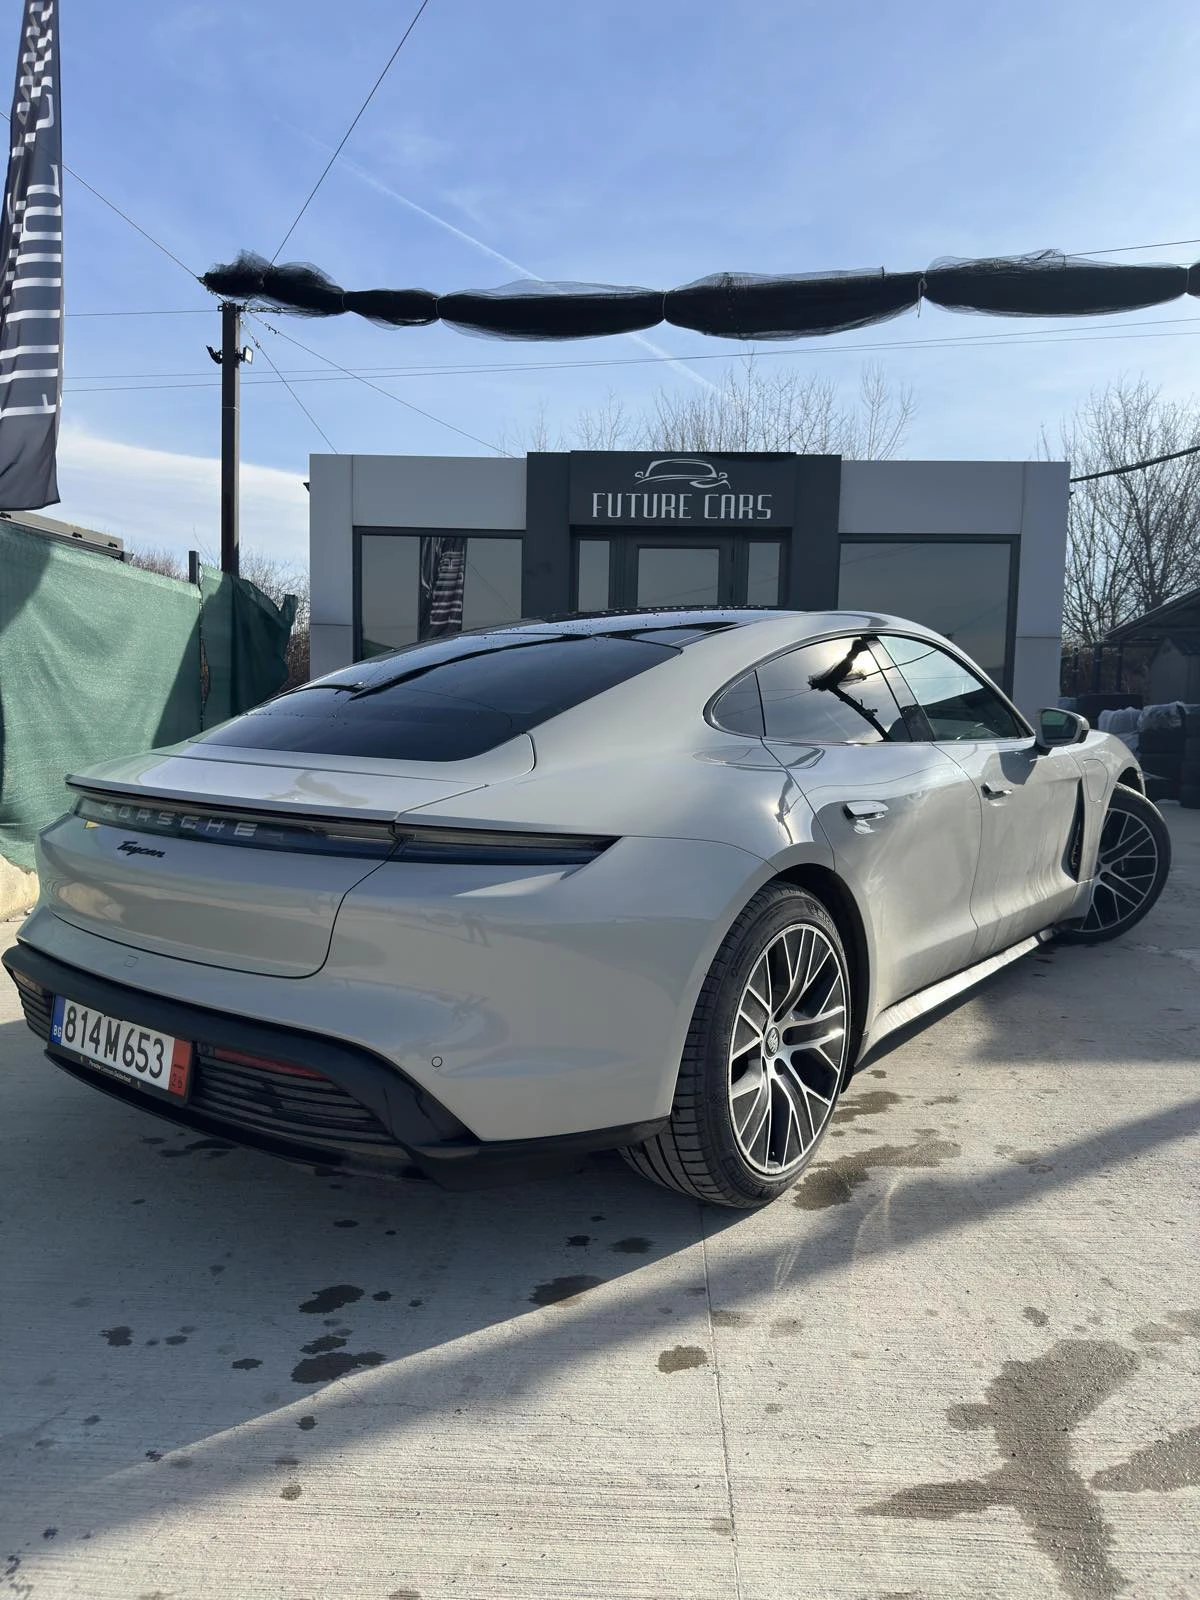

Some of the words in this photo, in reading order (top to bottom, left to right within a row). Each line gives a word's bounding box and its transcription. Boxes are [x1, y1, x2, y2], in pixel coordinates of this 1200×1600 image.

[592, 492, 693, 520] FUTURE
[703, 493, 773, 520] CARS
[116, 840, 166, 859] Taycan
[53, 1024, 62, 1038] BG
